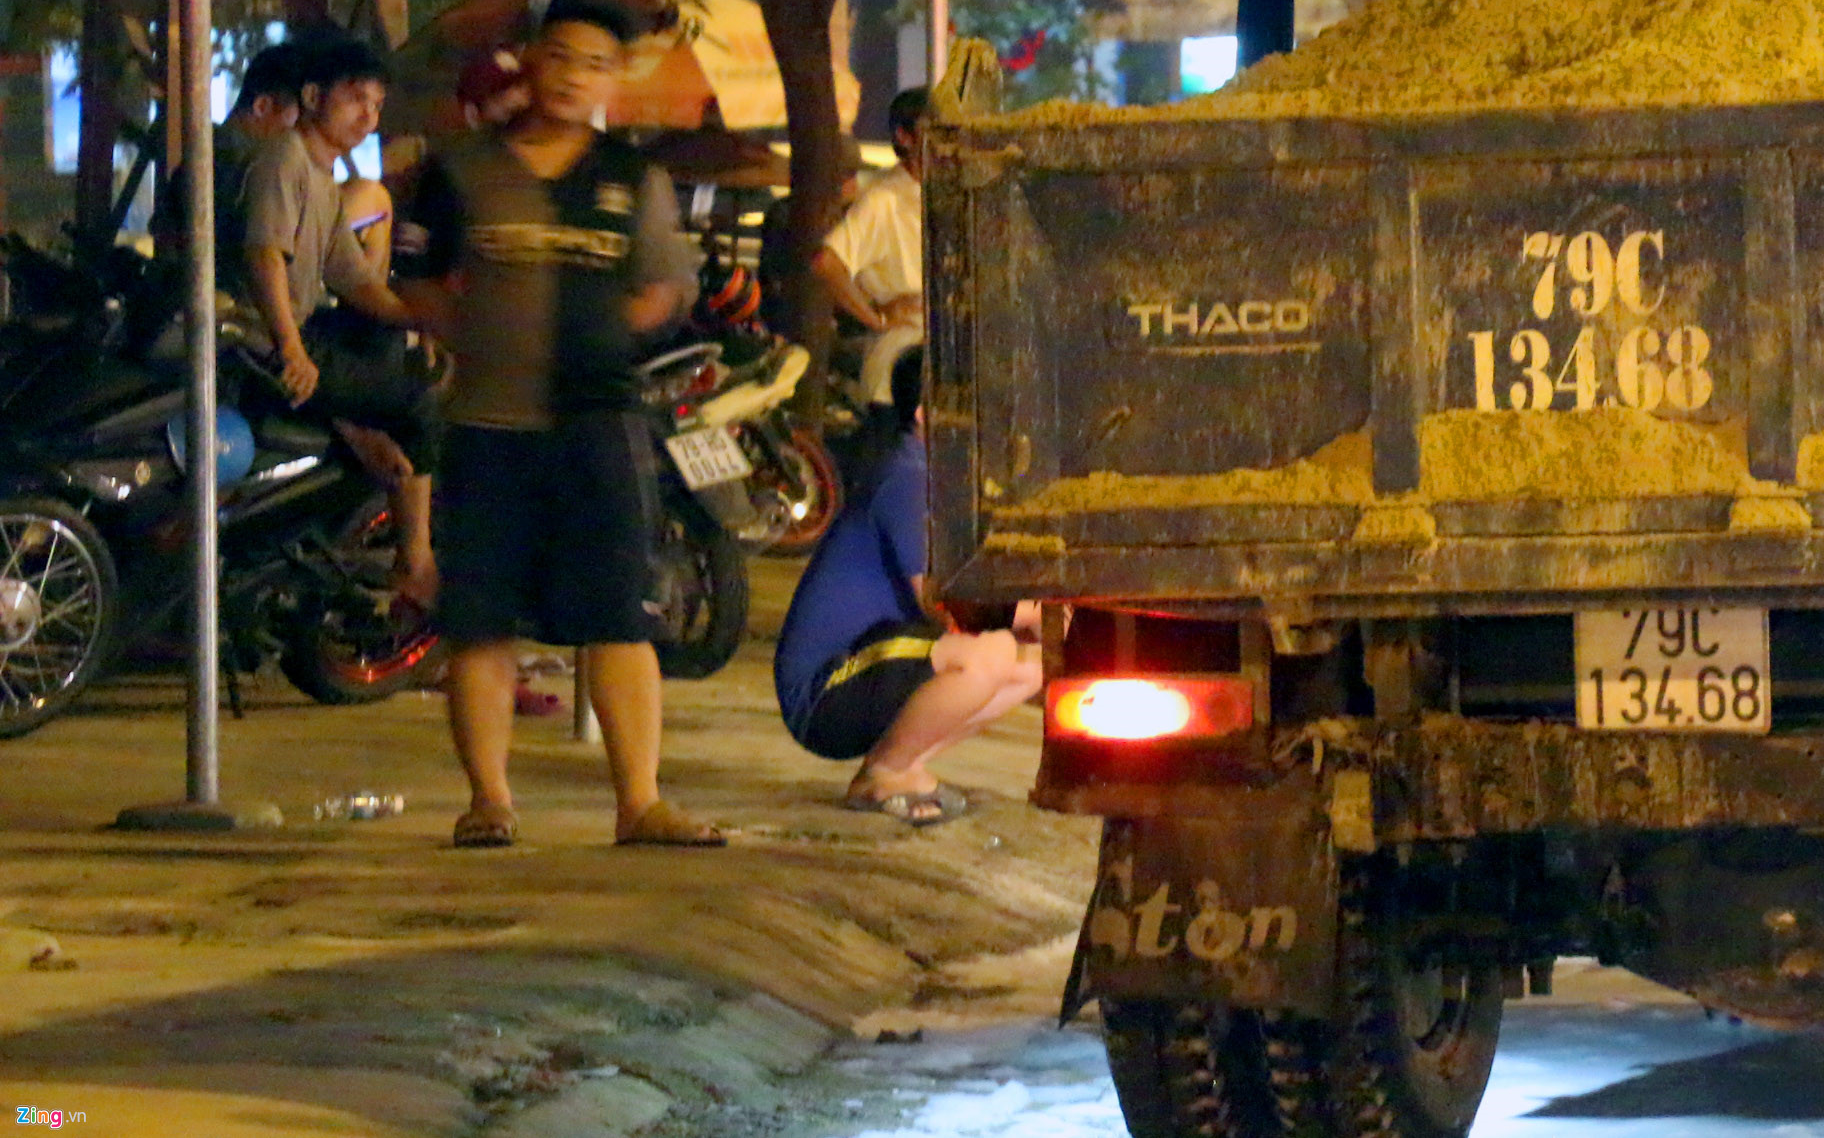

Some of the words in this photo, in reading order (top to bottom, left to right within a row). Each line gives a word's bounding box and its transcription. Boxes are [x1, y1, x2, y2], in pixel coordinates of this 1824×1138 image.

[1522, 230, 1666, 321] 79C
[1127, 300, 1311, 337] THACO
[1622, 608, 1721, 660] 79C
[1589, 664, 1761, 726] 134.68
